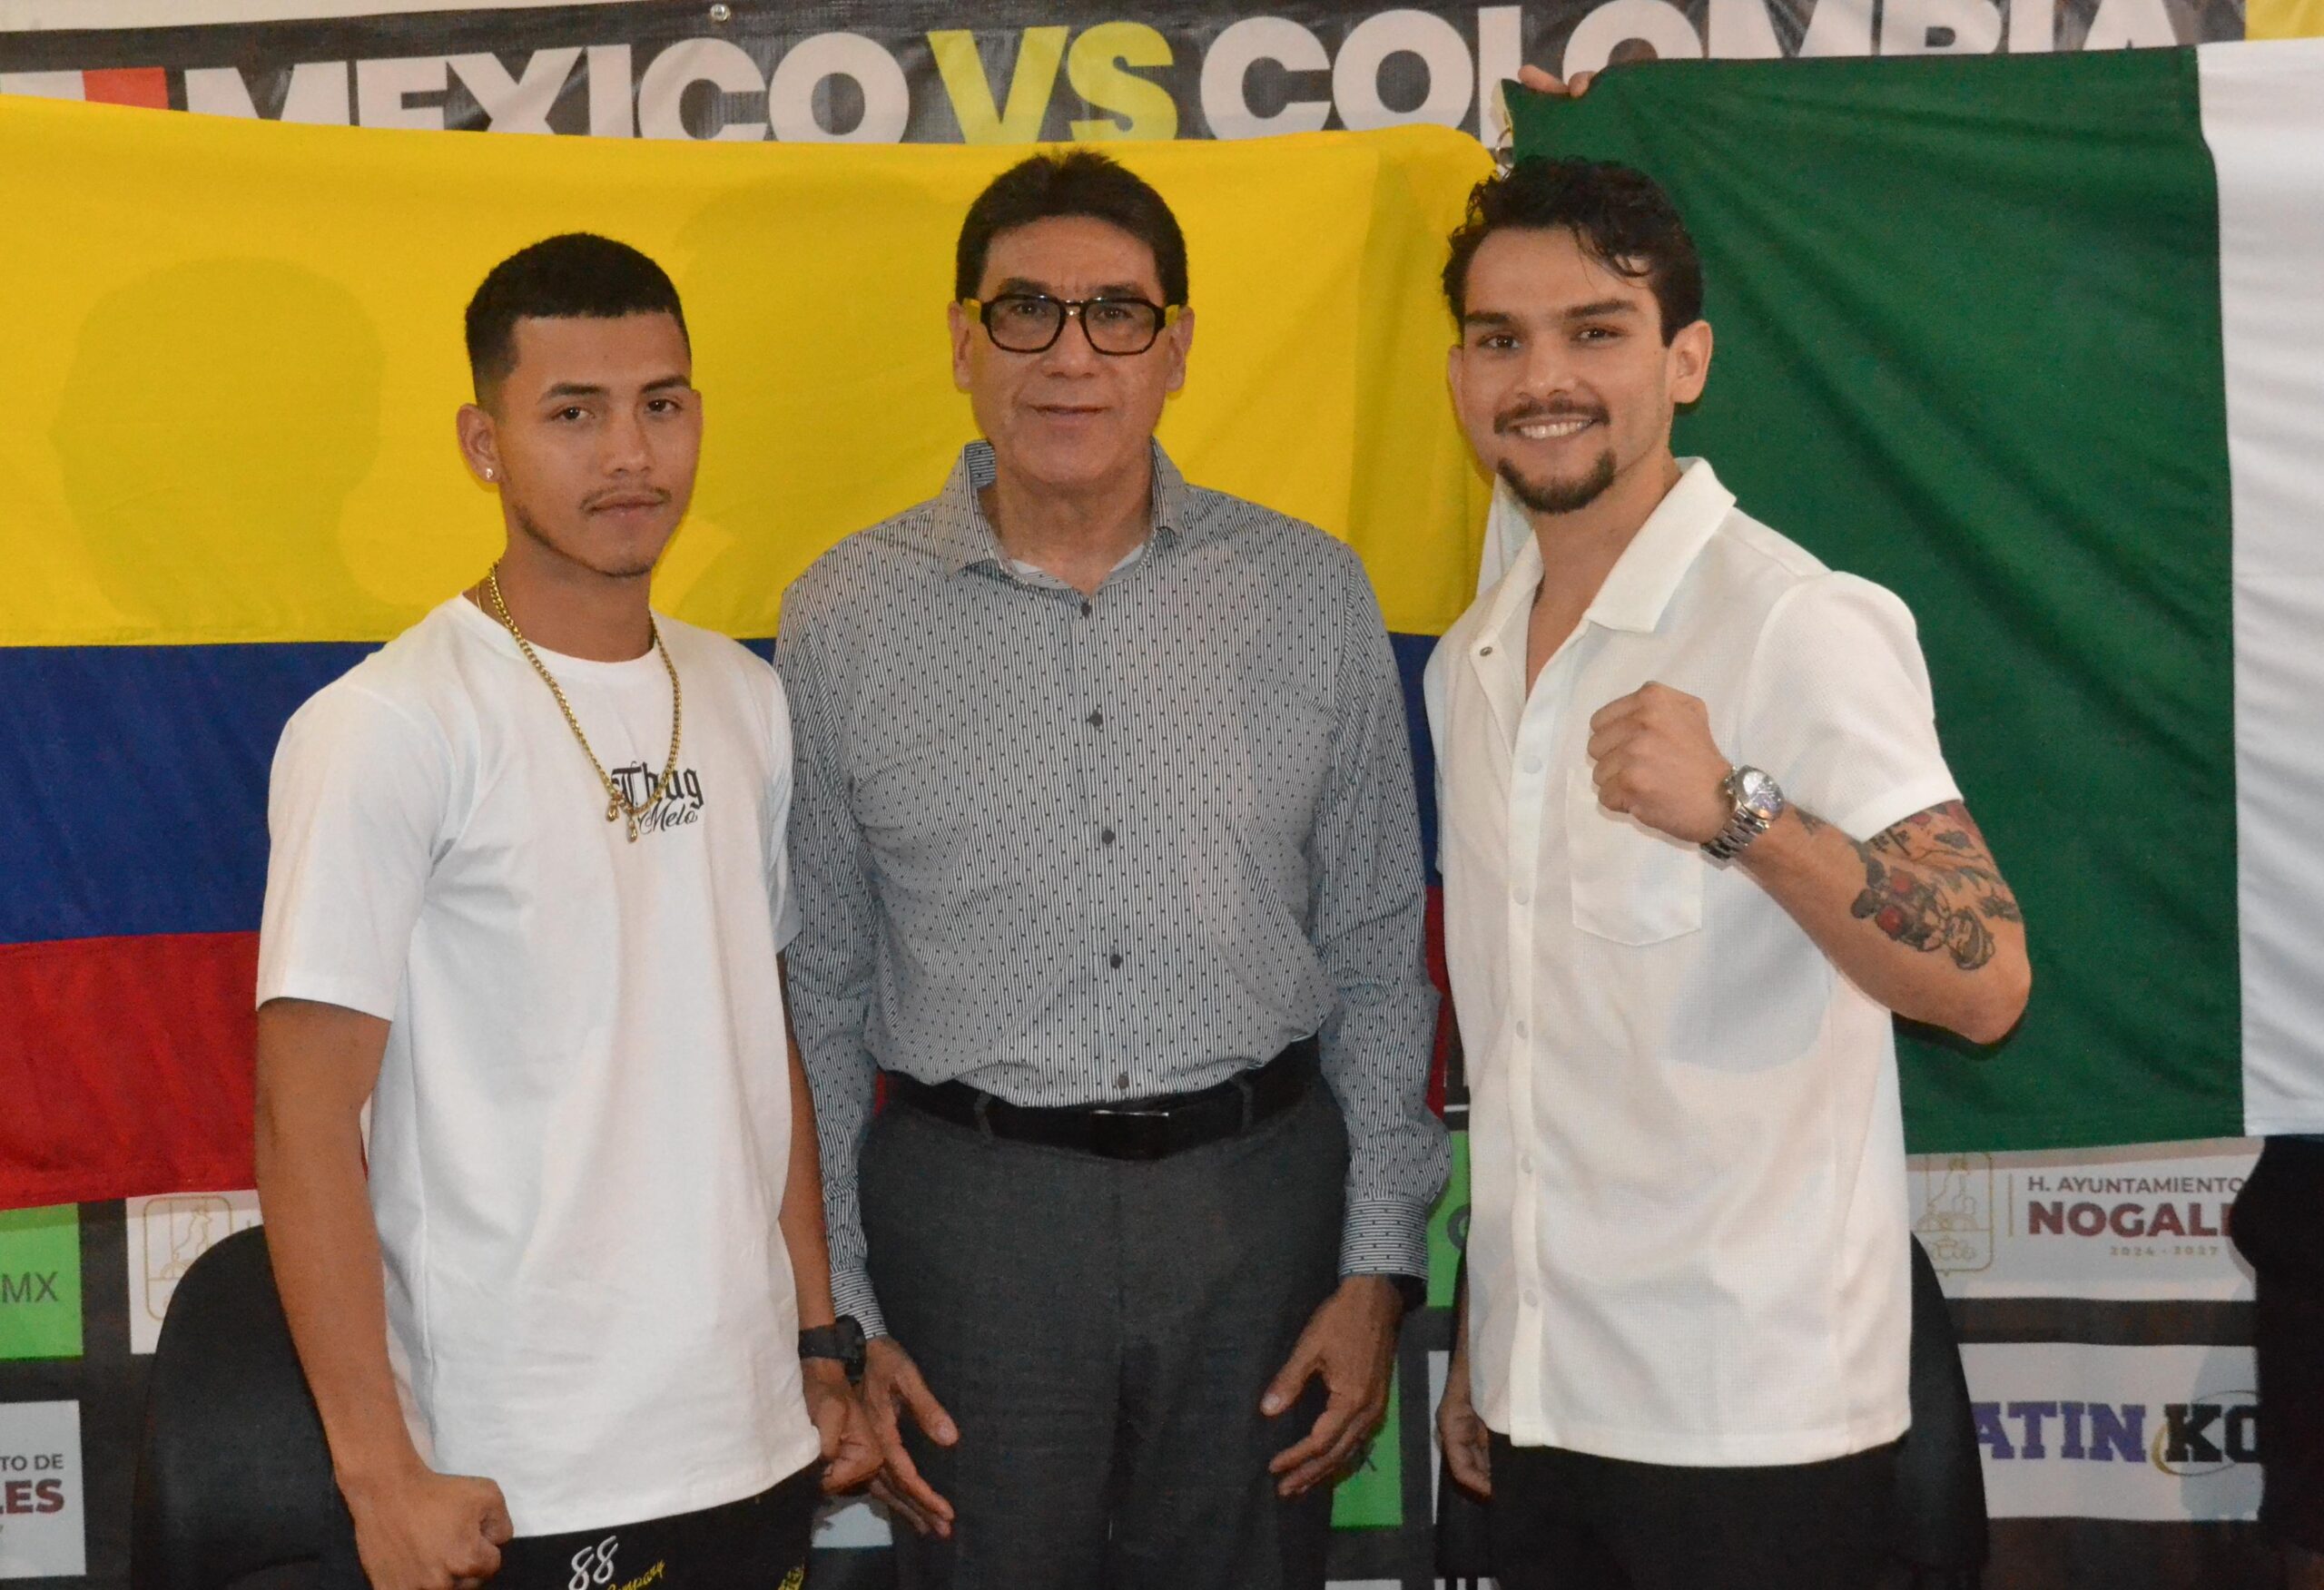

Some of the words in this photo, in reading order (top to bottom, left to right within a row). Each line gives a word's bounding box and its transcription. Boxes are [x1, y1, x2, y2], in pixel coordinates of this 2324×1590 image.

[927, 22, 1179, 144] VS
[610, 761, 704, 810] Thug
[2028, 1175, 2051, 1192] H.
[2056, 1176, 2246, 1194] AYUNTAMIENTO
[2163, 1403, 2260, 1463] KO
[34, 1453, 64, 1470] DE
[0, 1478, 64, 1515] ES
[568, 1535, 618, 1590] 88
